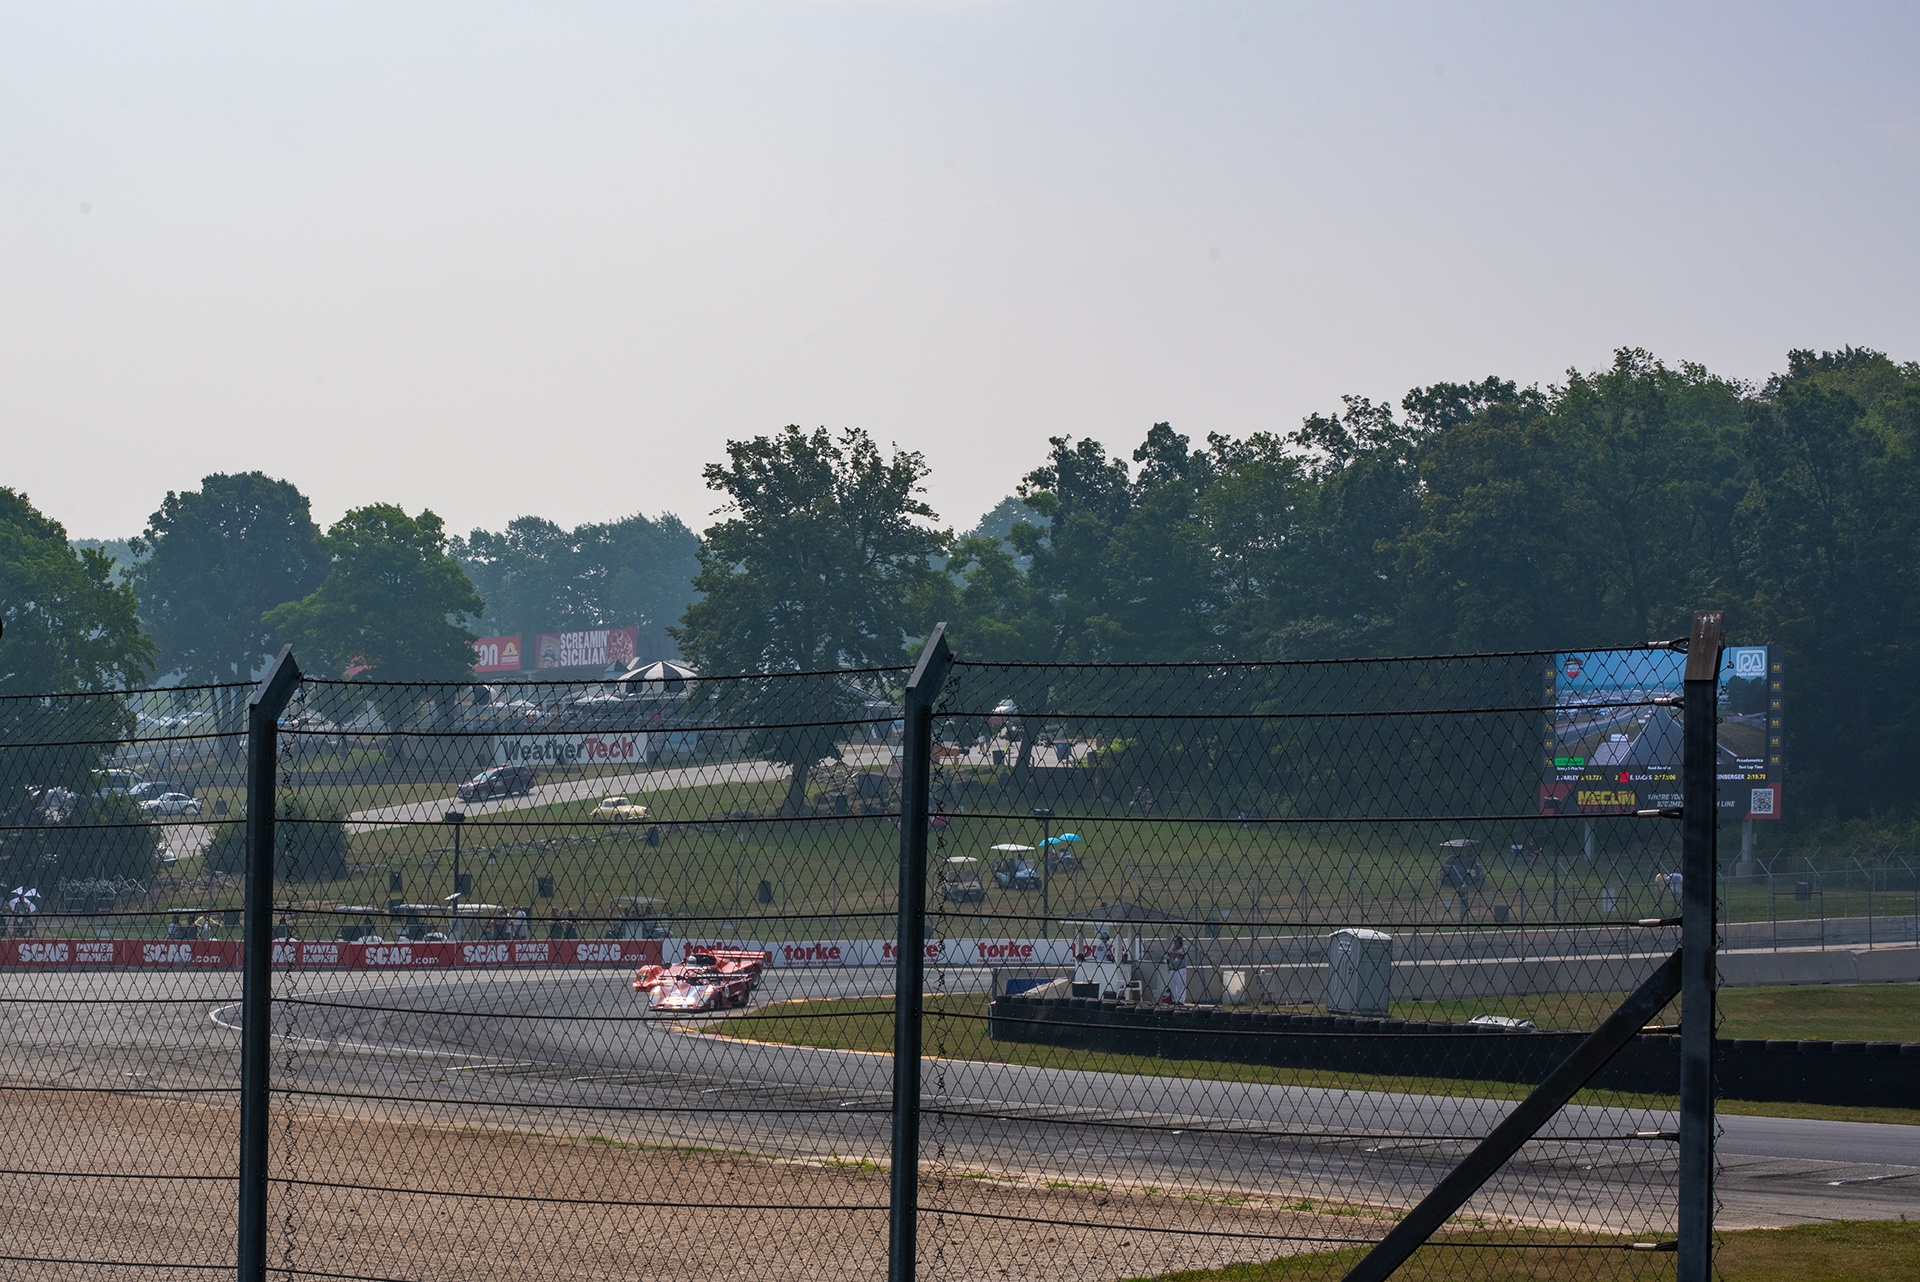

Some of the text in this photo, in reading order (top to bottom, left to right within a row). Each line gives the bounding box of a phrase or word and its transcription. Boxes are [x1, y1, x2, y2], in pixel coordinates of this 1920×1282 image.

[560, 630, 610, 650] SCREAMIN'
[560, 647, 607, 667] SICILIAN
[503, 737, 634, 761] WeatherTech
[1578, 791, 1636, 805] MECUM
[18, 943, 68, 962] SCAG
[76, 943, 114, 952] POWER
[271, 944, 296, 963] AG
[303, 945, 338, 954] POWER
[463, 945, 509, 962] SCAG
[515, 943, 549, 953] POWER
[784, 943, 841, 960] torke
[978, 942, 1032, 958] torke
